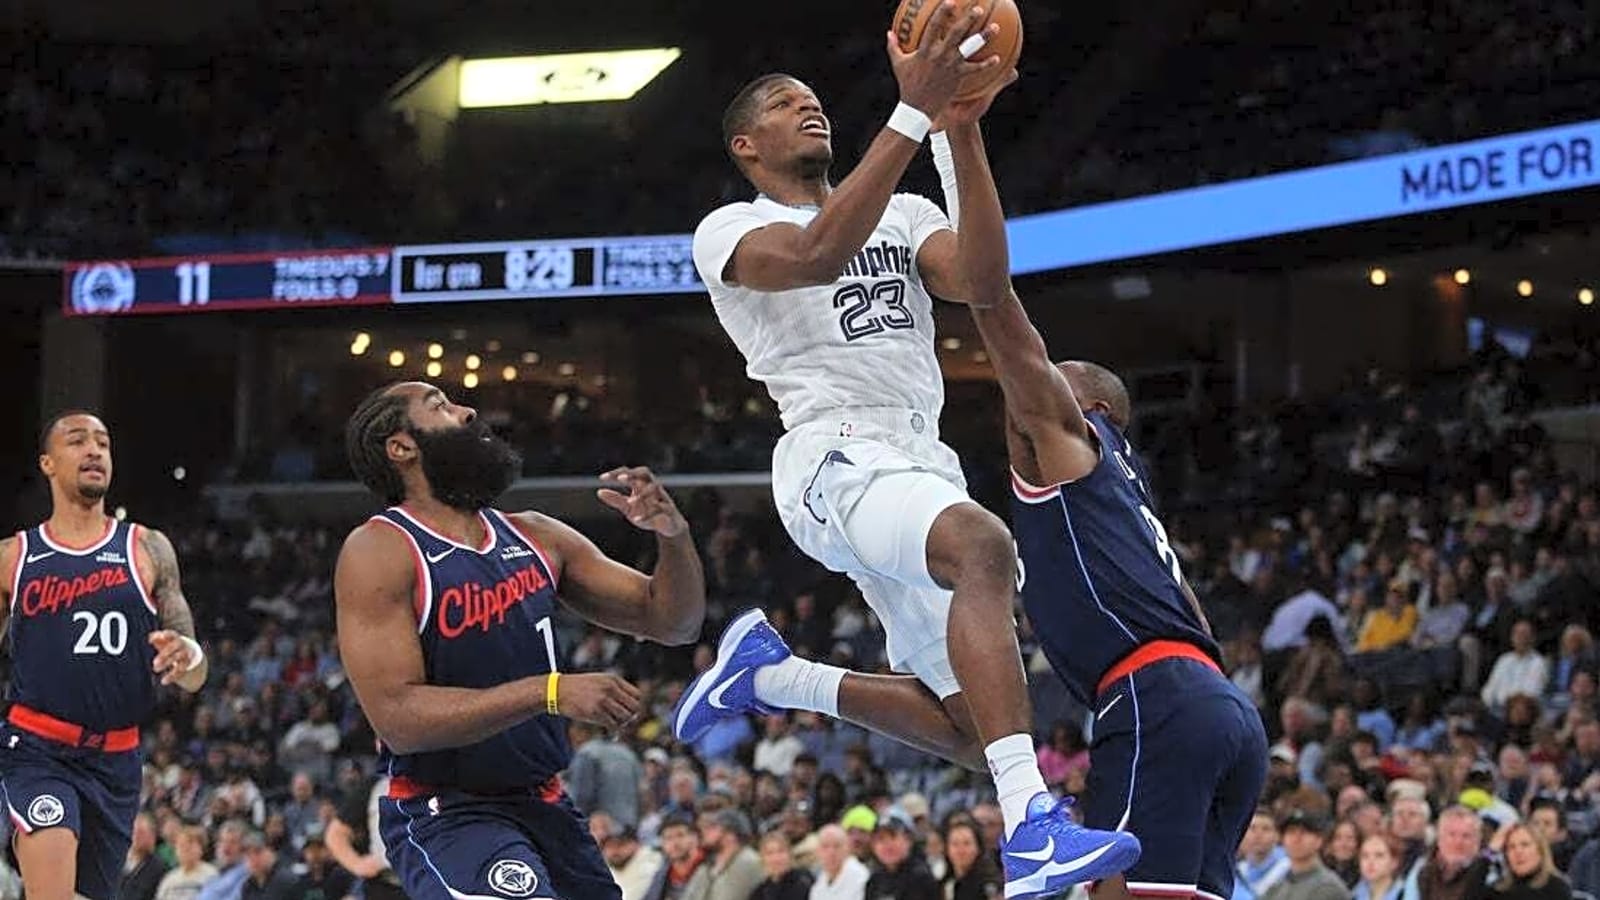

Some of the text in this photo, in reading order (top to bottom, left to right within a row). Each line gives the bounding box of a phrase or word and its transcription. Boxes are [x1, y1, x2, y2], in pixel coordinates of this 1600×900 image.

[1402, 138, 1593, 204] MADE FOR
[175, 261, 210, 305] 11
[505, 247, 574, 291] 8:29
[833, 279, 915, 342] 23
[22, 566, 129, 617] Clippers
[437, 563, 548, 640] Clippers
[72, 610, 128, 656] 20
